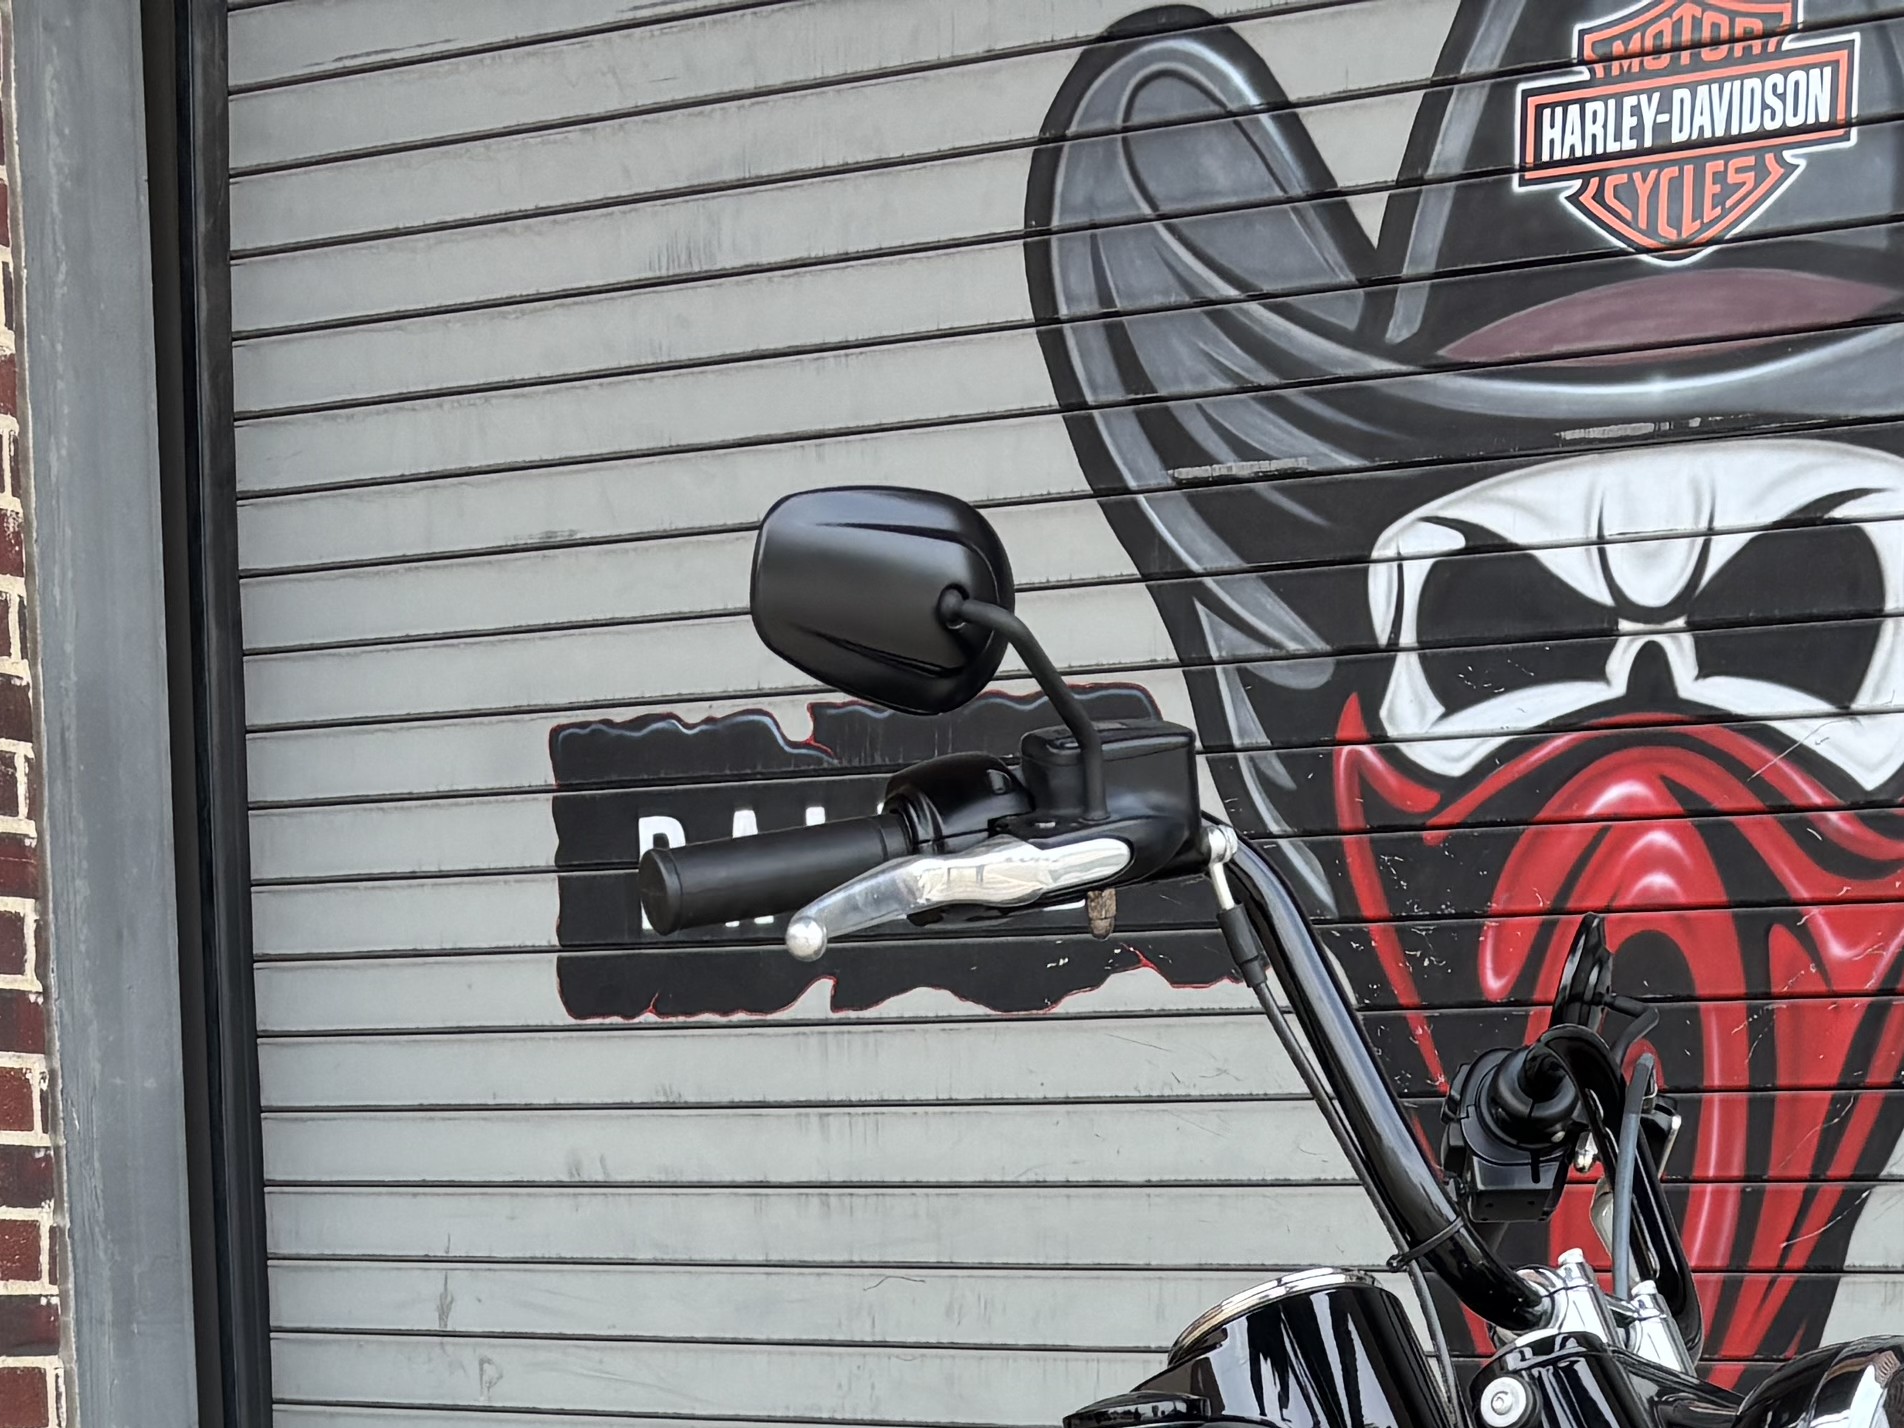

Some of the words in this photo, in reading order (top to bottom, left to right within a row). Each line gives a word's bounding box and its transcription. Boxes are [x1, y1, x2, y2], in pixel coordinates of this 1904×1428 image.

[1611, 2, 1766, 77] MOTOR
[1541, 66, 1833, 163] HARLEY-DAVIDSON
[1603, 155, 1757, 241] CYCLES
